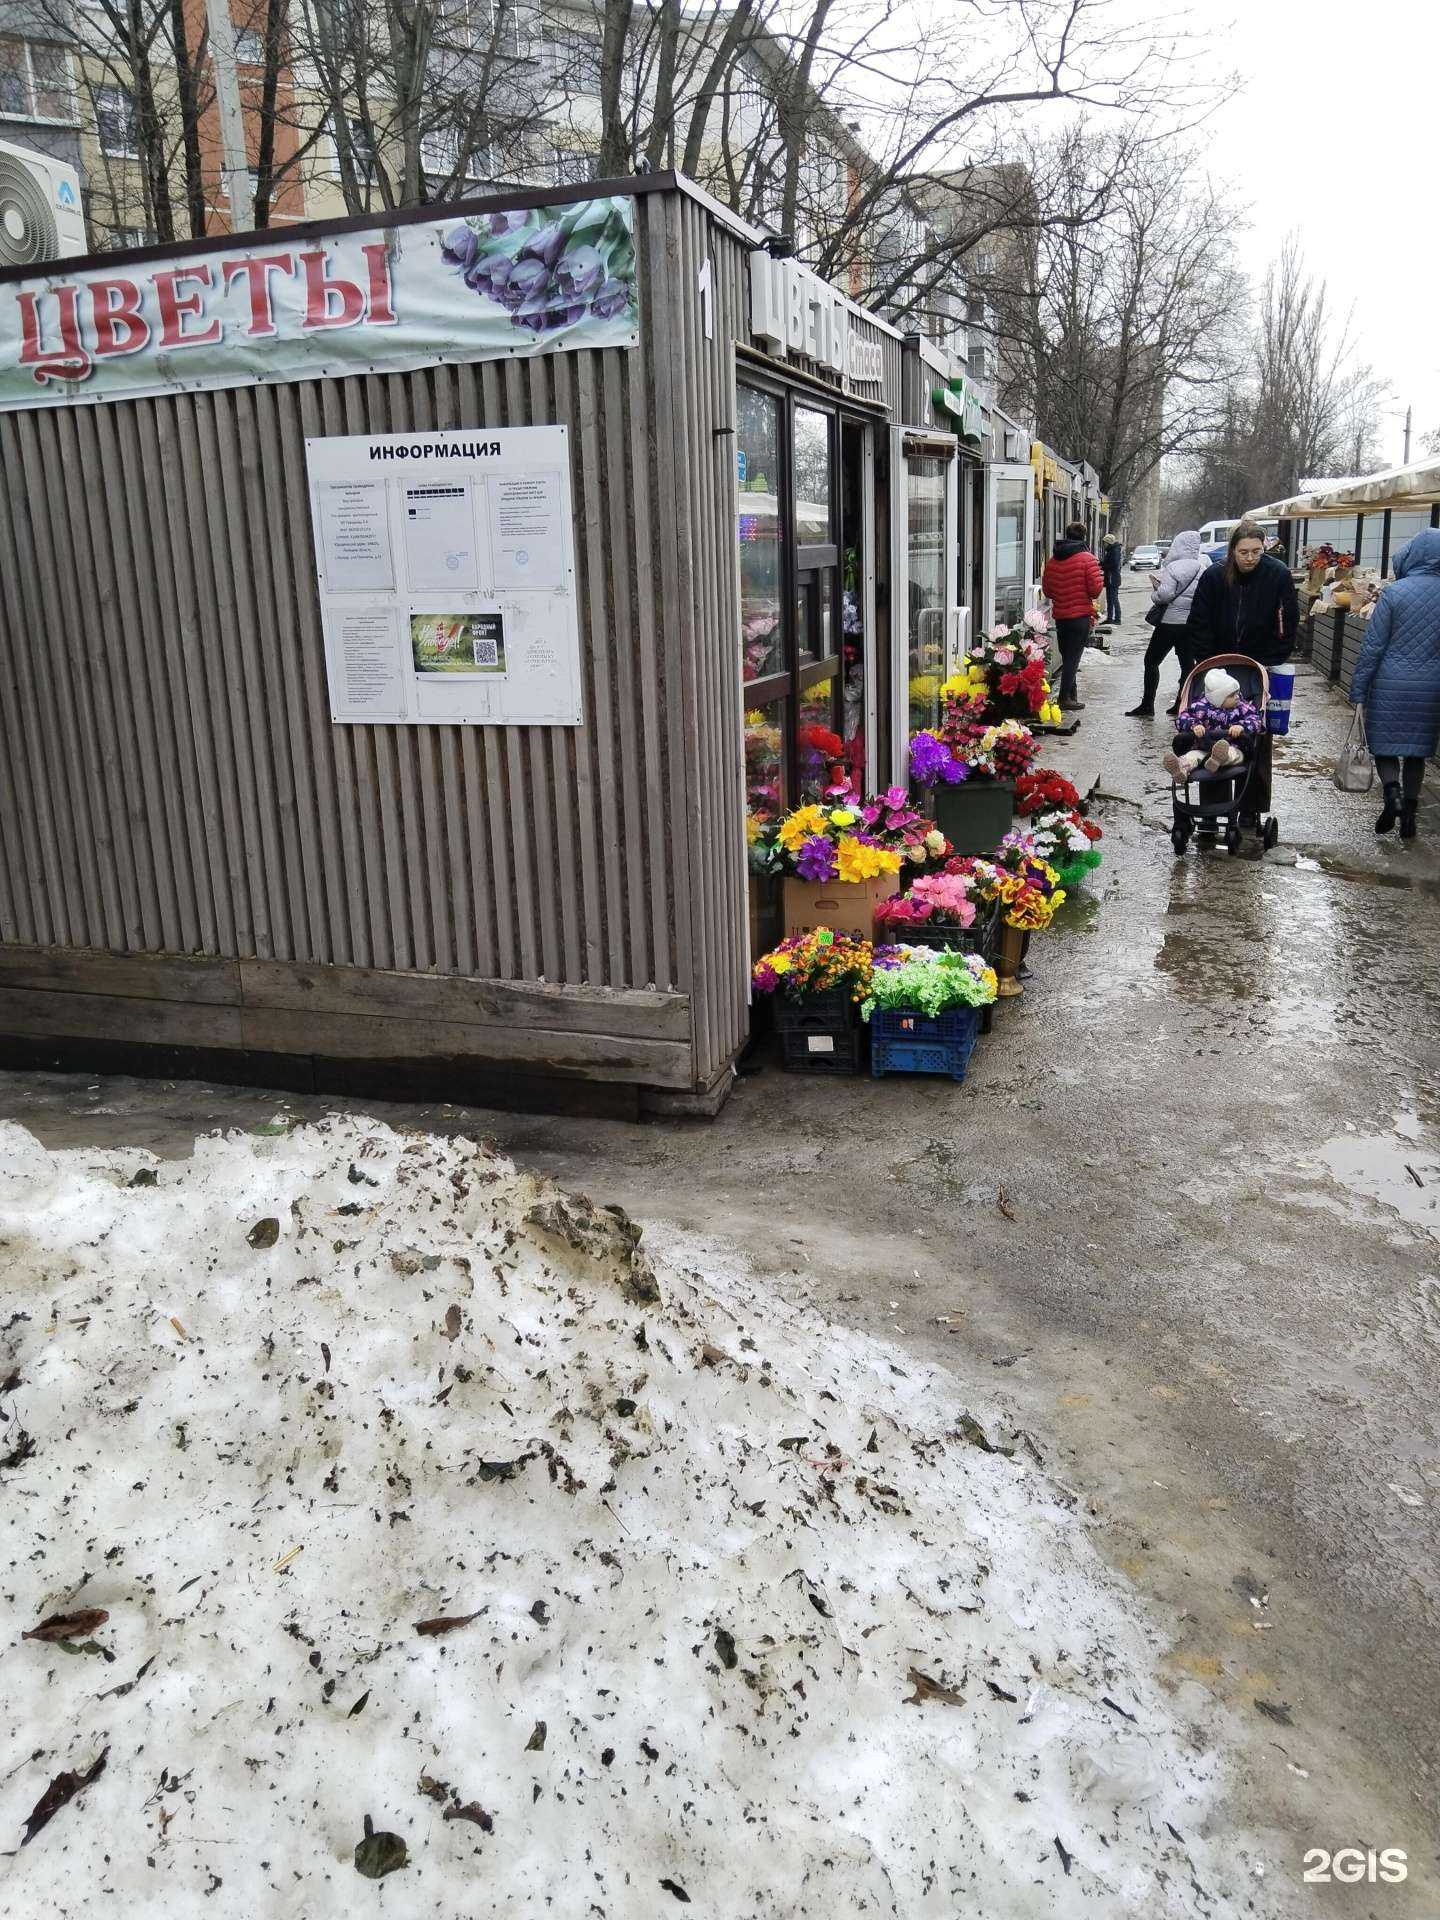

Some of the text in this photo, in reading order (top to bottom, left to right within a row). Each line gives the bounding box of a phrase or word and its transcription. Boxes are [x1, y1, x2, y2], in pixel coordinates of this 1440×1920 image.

[16, 243, 398, 384] ЦВЕТЫ
[698, 256, 713, 340] 1
[750, 250, 850, 377] ЦВЕТЫ
[369, 441, 502, 460] ИНФОРМАЦИЯ
